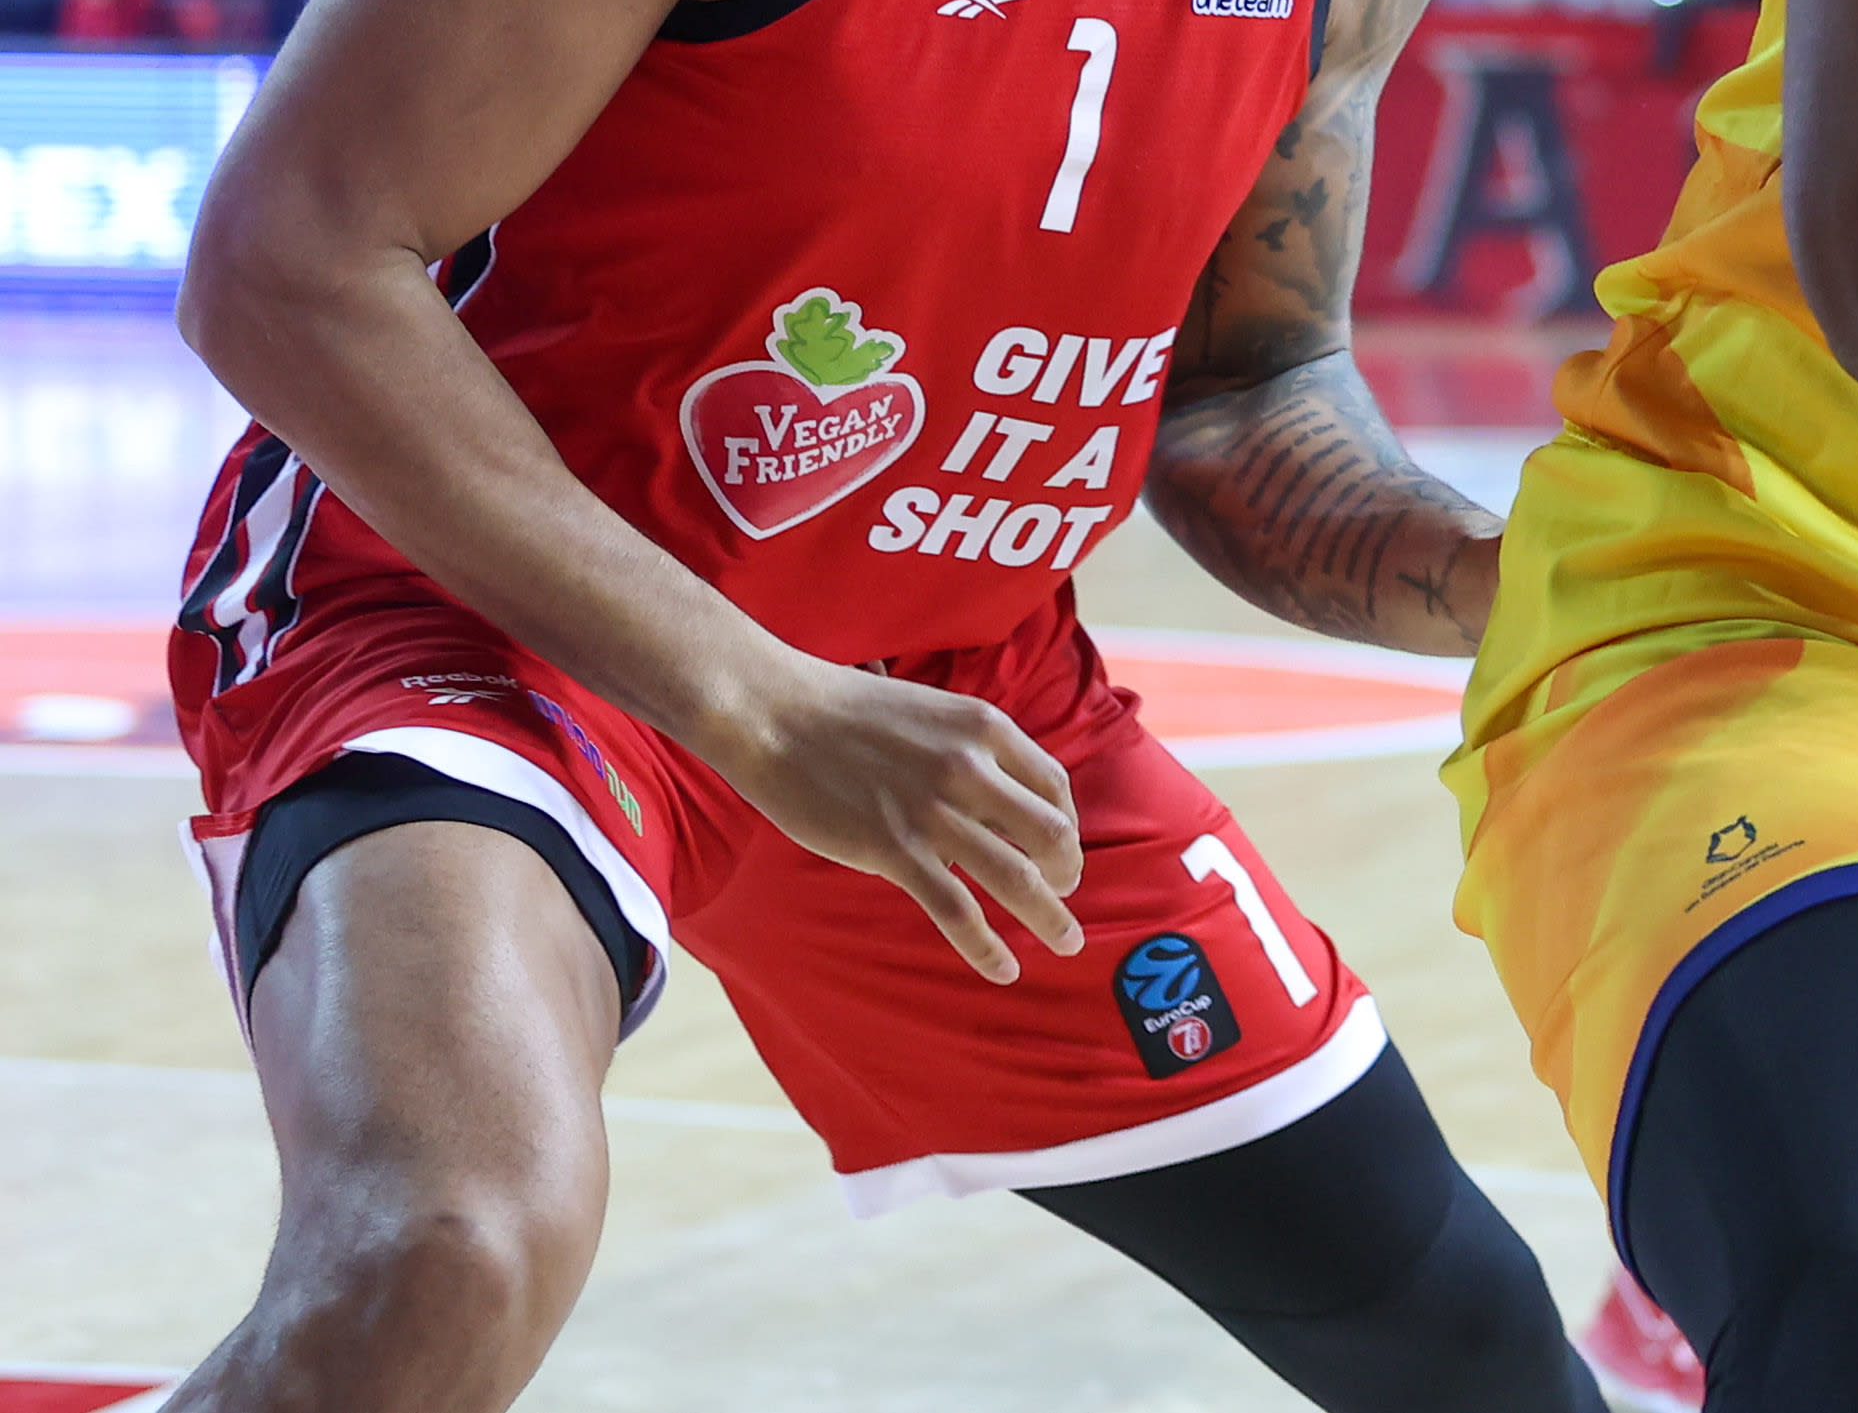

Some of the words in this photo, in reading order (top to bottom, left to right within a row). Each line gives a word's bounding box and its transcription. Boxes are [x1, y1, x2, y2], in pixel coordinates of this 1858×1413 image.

[1039, 17, 1119, 234] 1
[0, 144, 190, 266] EX
[972, 325, 1178, 407] GIVE
[724, 413, 903, 485] FRIENDLY
[939, 411, 1055, 481] IT
[1043, 425, 1120, 489] A
[868, 486, 1113, 570] SHOT
[400, 671, 518, 689] Reebok
[1179, 833, 1319, 1008] 1
[1143, 995, 1212, 1034] EuroCup
